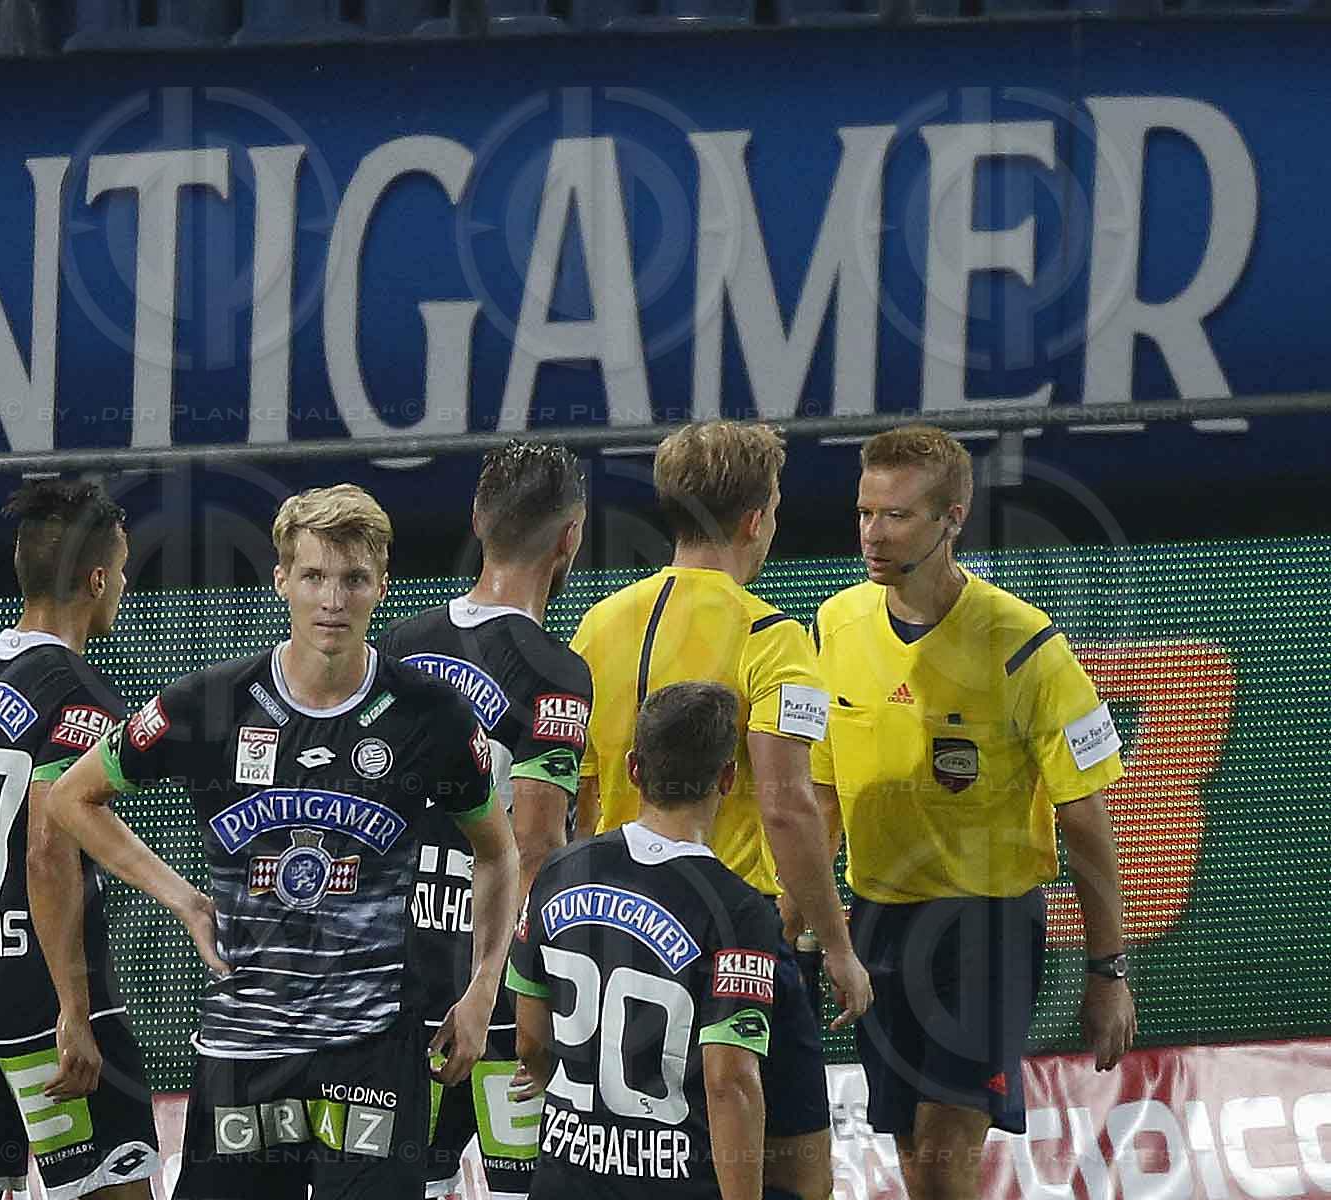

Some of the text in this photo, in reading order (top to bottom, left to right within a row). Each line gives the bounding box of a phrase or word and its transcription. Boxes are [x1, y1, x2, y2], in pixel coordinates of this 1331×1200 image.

[417, 660, 502, 721] TIGAMER
[539, 697, 589, 722] KLEIN
[240, 767, 270, 781] LIGA
[220, 796, 396, 845] PUNTIGAMER
[548, 893, 688, 965] PUNTIGAMER
[717, 954, 775, 976] KLEIN
[715, 976, 773, 998] ZEITUN
[540, 945, 695, 1125] 20
[322, 1083, 397, 1108] HOLDING
[219, 1104, 386, 1153] GRAZ
